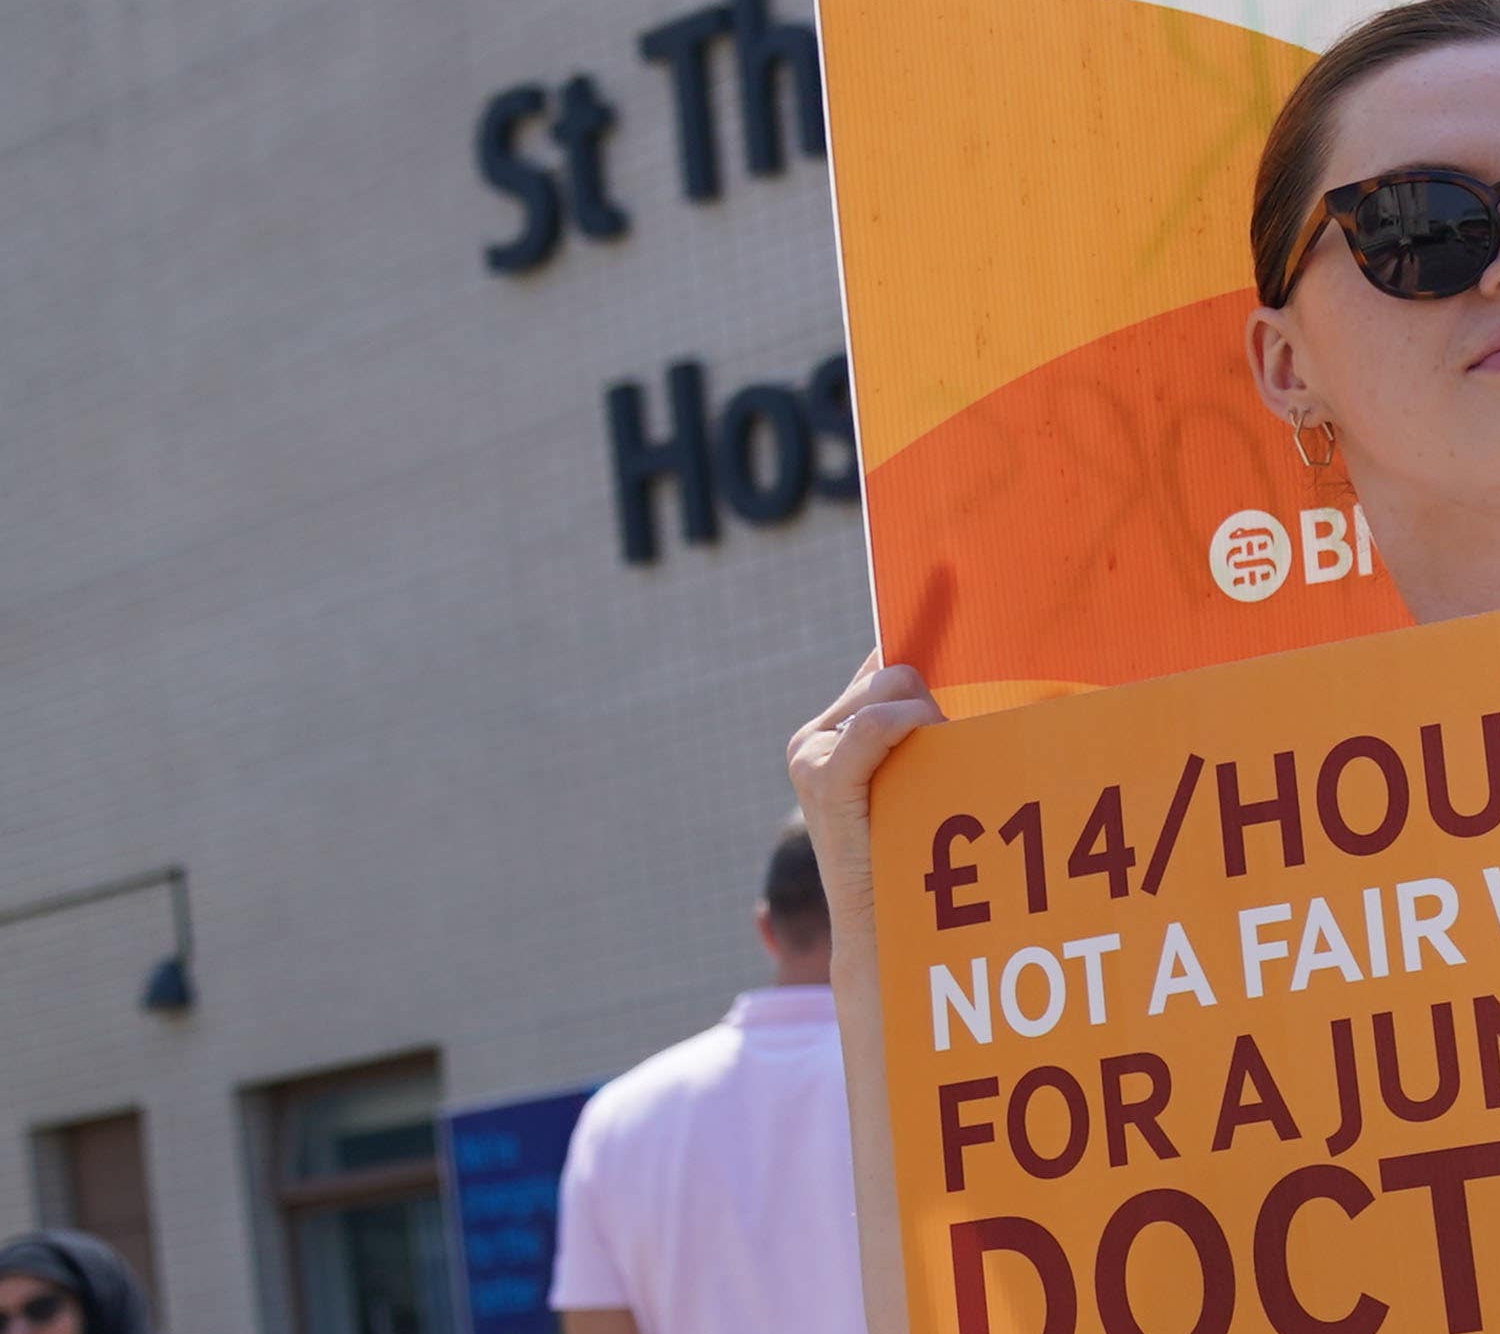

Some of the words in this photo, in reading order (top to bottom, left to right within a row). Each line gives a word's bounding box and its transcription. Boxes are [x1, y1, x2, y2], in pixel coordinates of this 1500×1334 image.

[476, 70, 628, 275] St
[930, 934, 1120, 1051] NOT
[1148, 923, 1217, 1015] A
[1239, 878, 1466, 998] FAIR
[939, 1052, 1181, 1192] FOR
[1212, 1034, 1302, 1152] A
